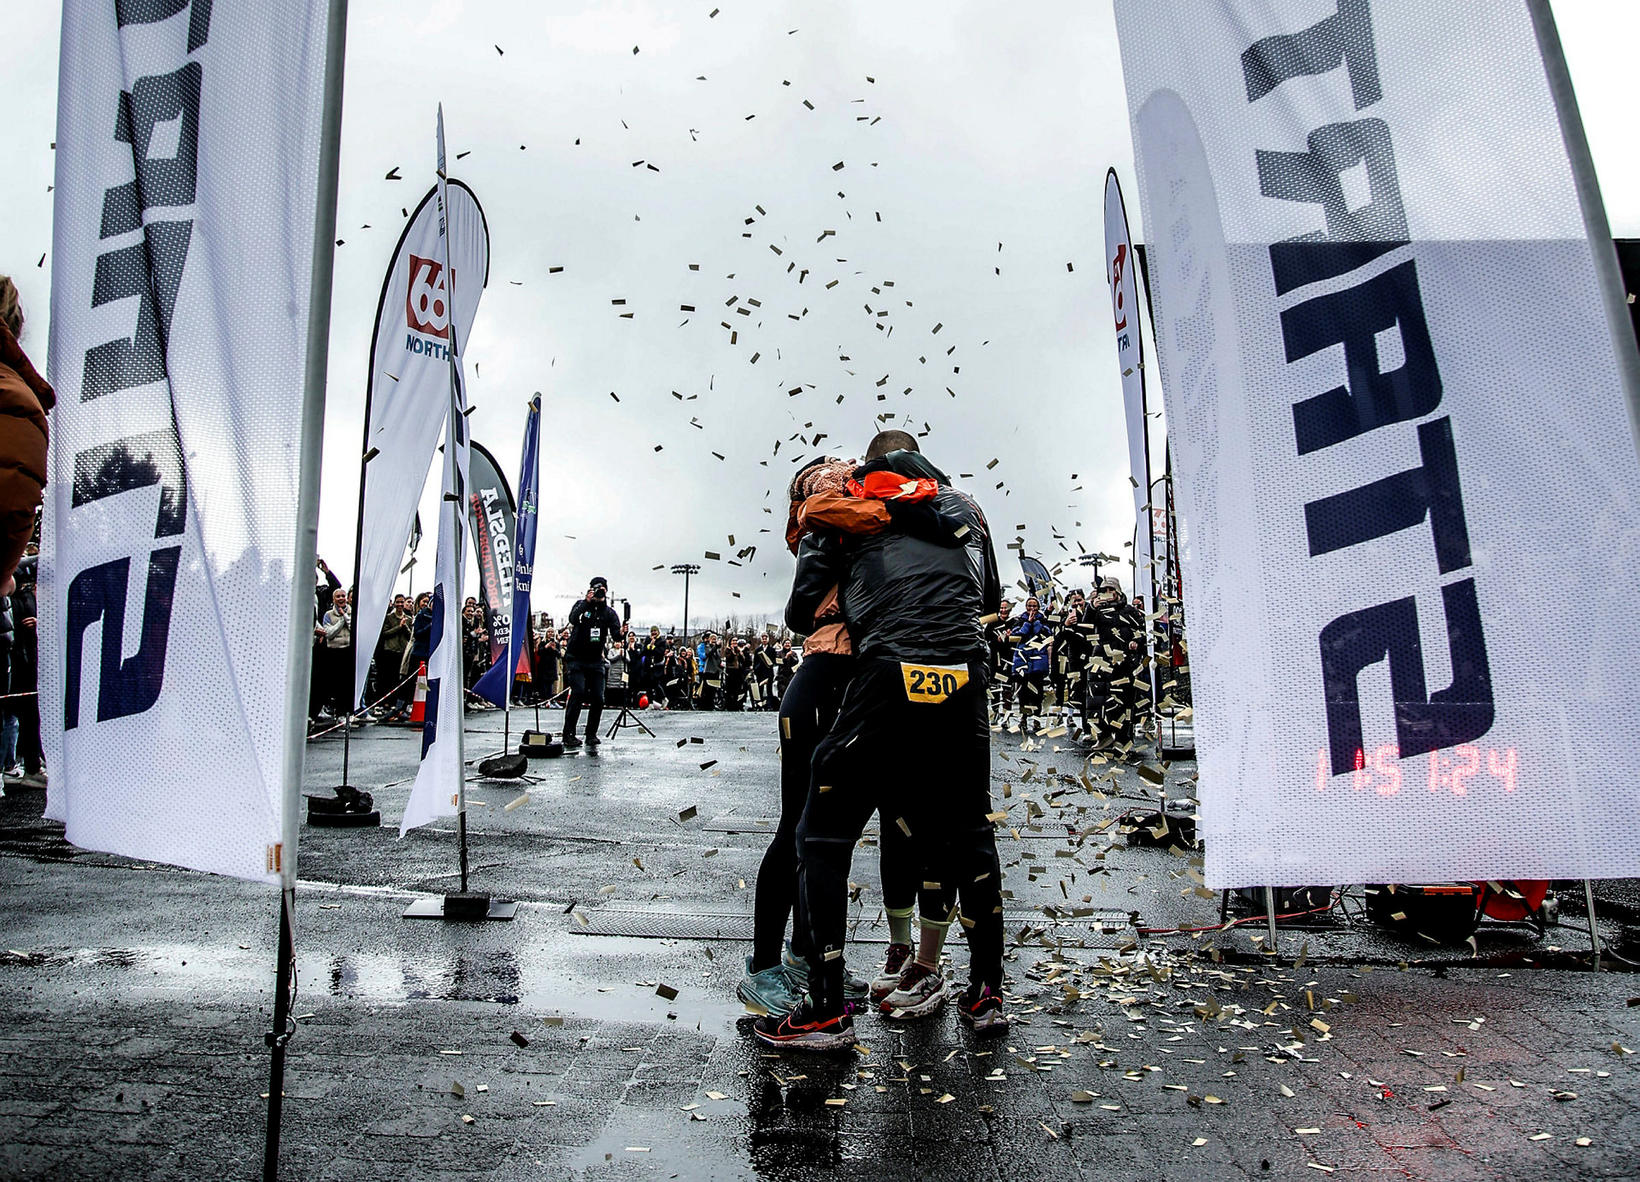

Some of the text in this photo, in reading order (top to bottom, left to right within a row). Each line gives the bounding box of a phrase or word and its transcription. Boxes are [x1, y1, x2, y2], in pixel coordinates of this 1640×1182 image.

[406, 334, 451, 362] NORTH
[910, 670, 957, 696] 230
[1316, 745, 1517, 795] 11:51:24
